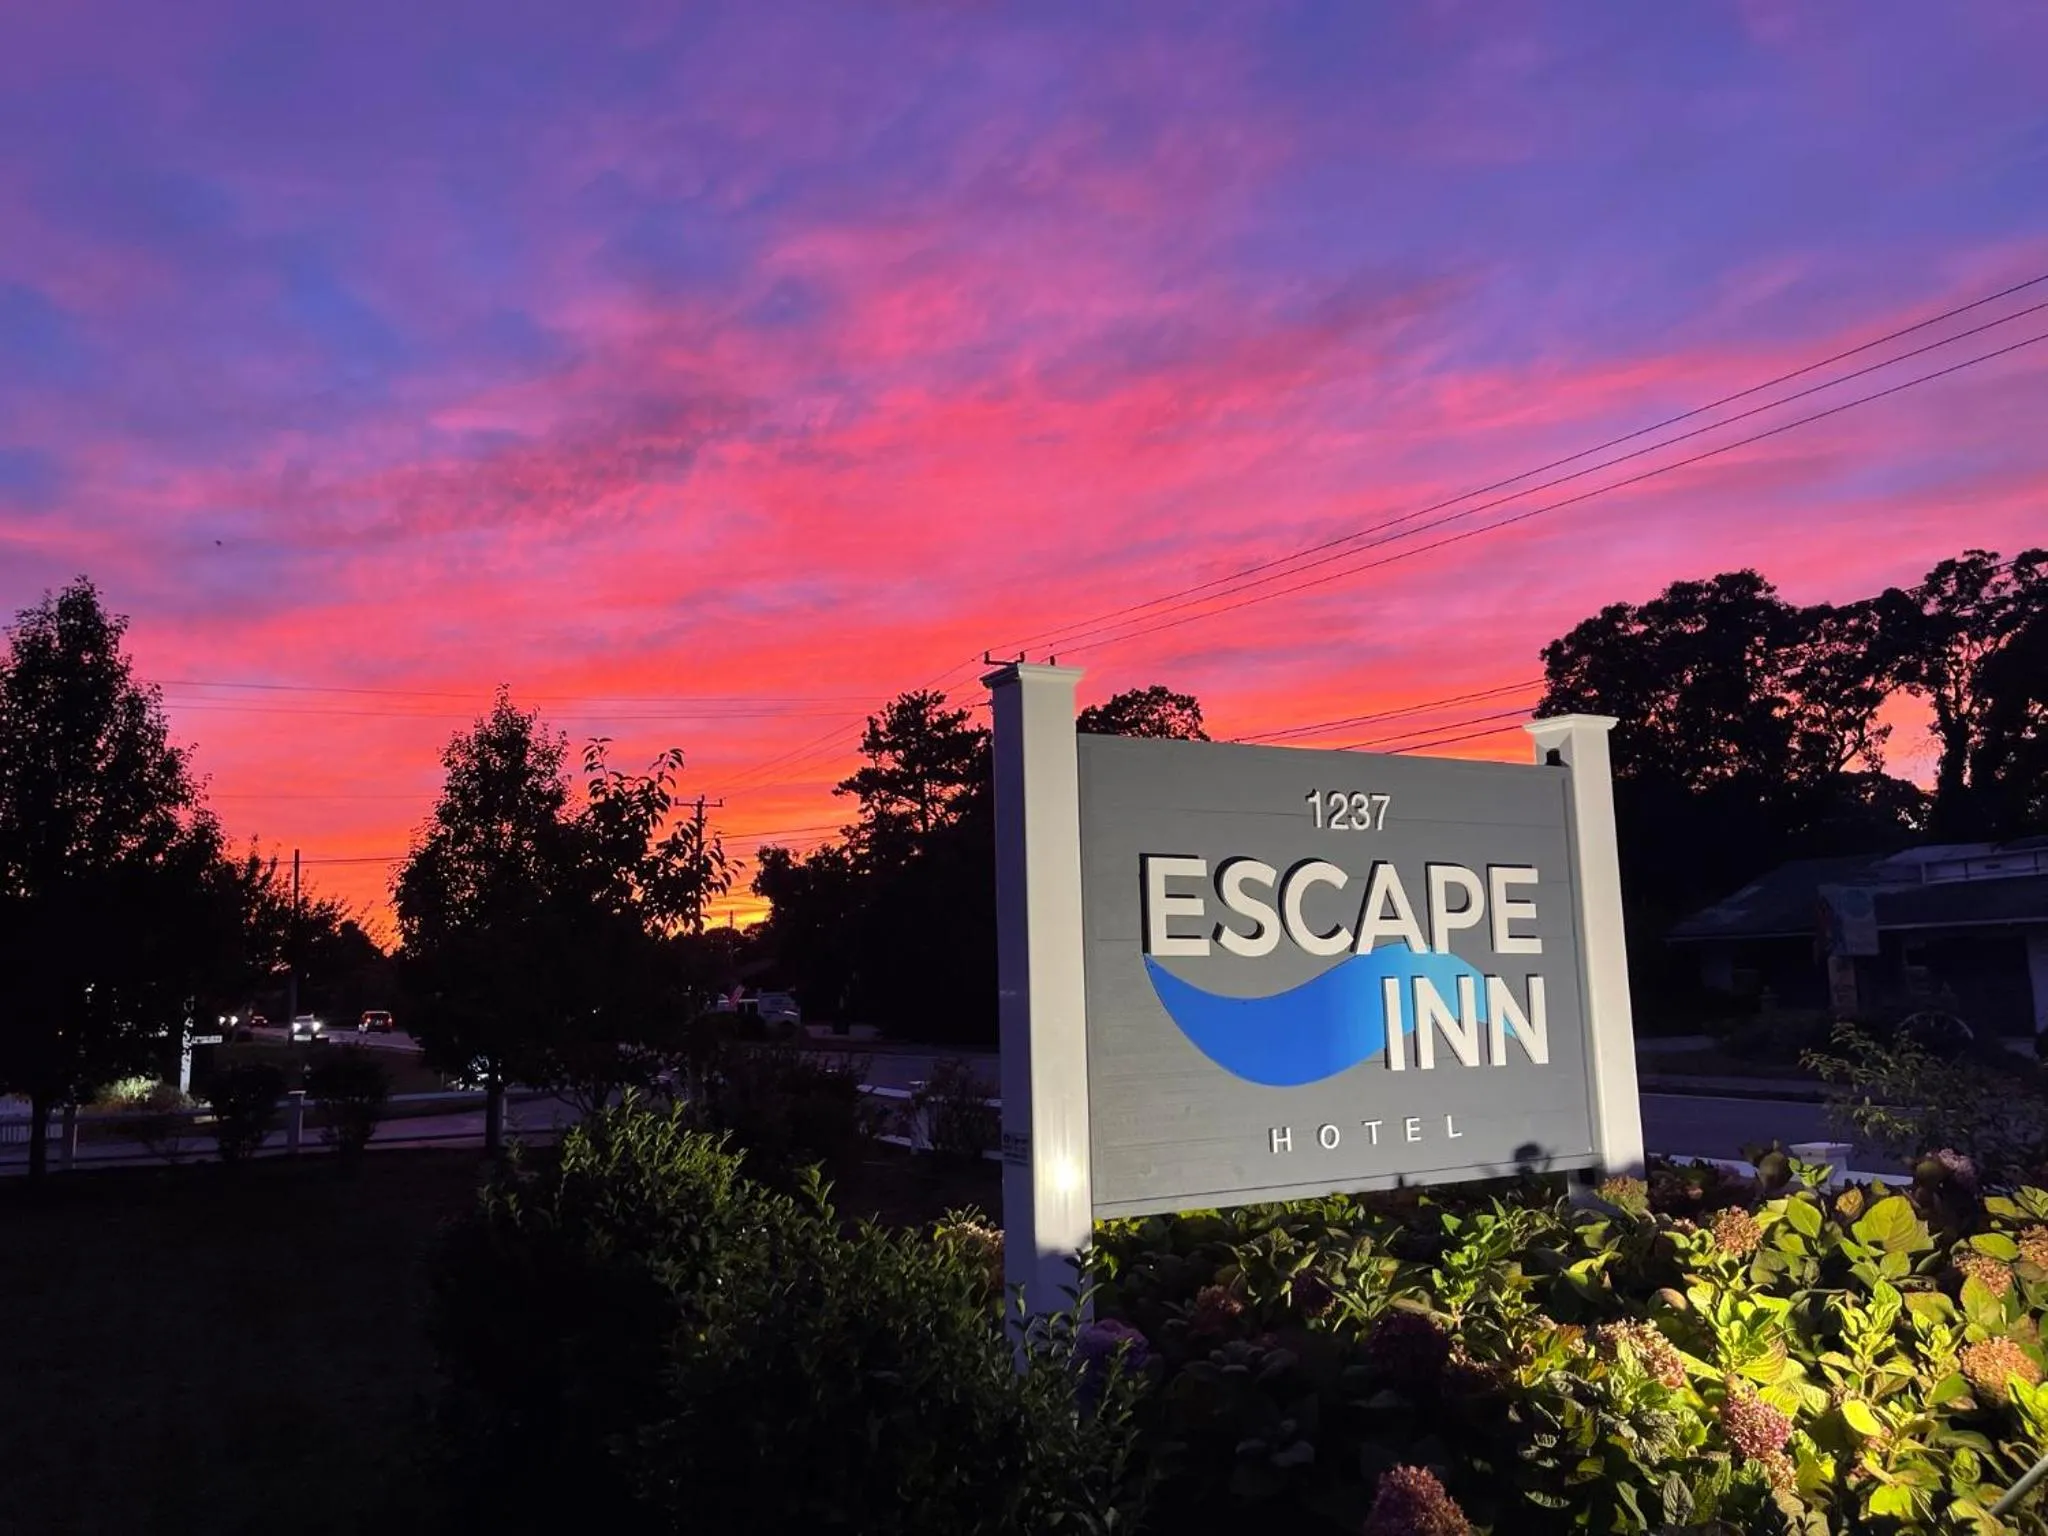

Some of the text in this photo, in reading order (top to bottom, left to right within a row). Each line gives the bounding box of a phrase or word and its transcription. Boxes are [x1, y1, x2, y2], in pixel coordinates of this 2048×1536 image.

[1306, 789, 1391, 831] 1237
[1142, 855, 1542, 957] ESCAPE
[1382, 975, 1549, 1071] INN
[1271, 1114, 1462, 1153] HOTEL
